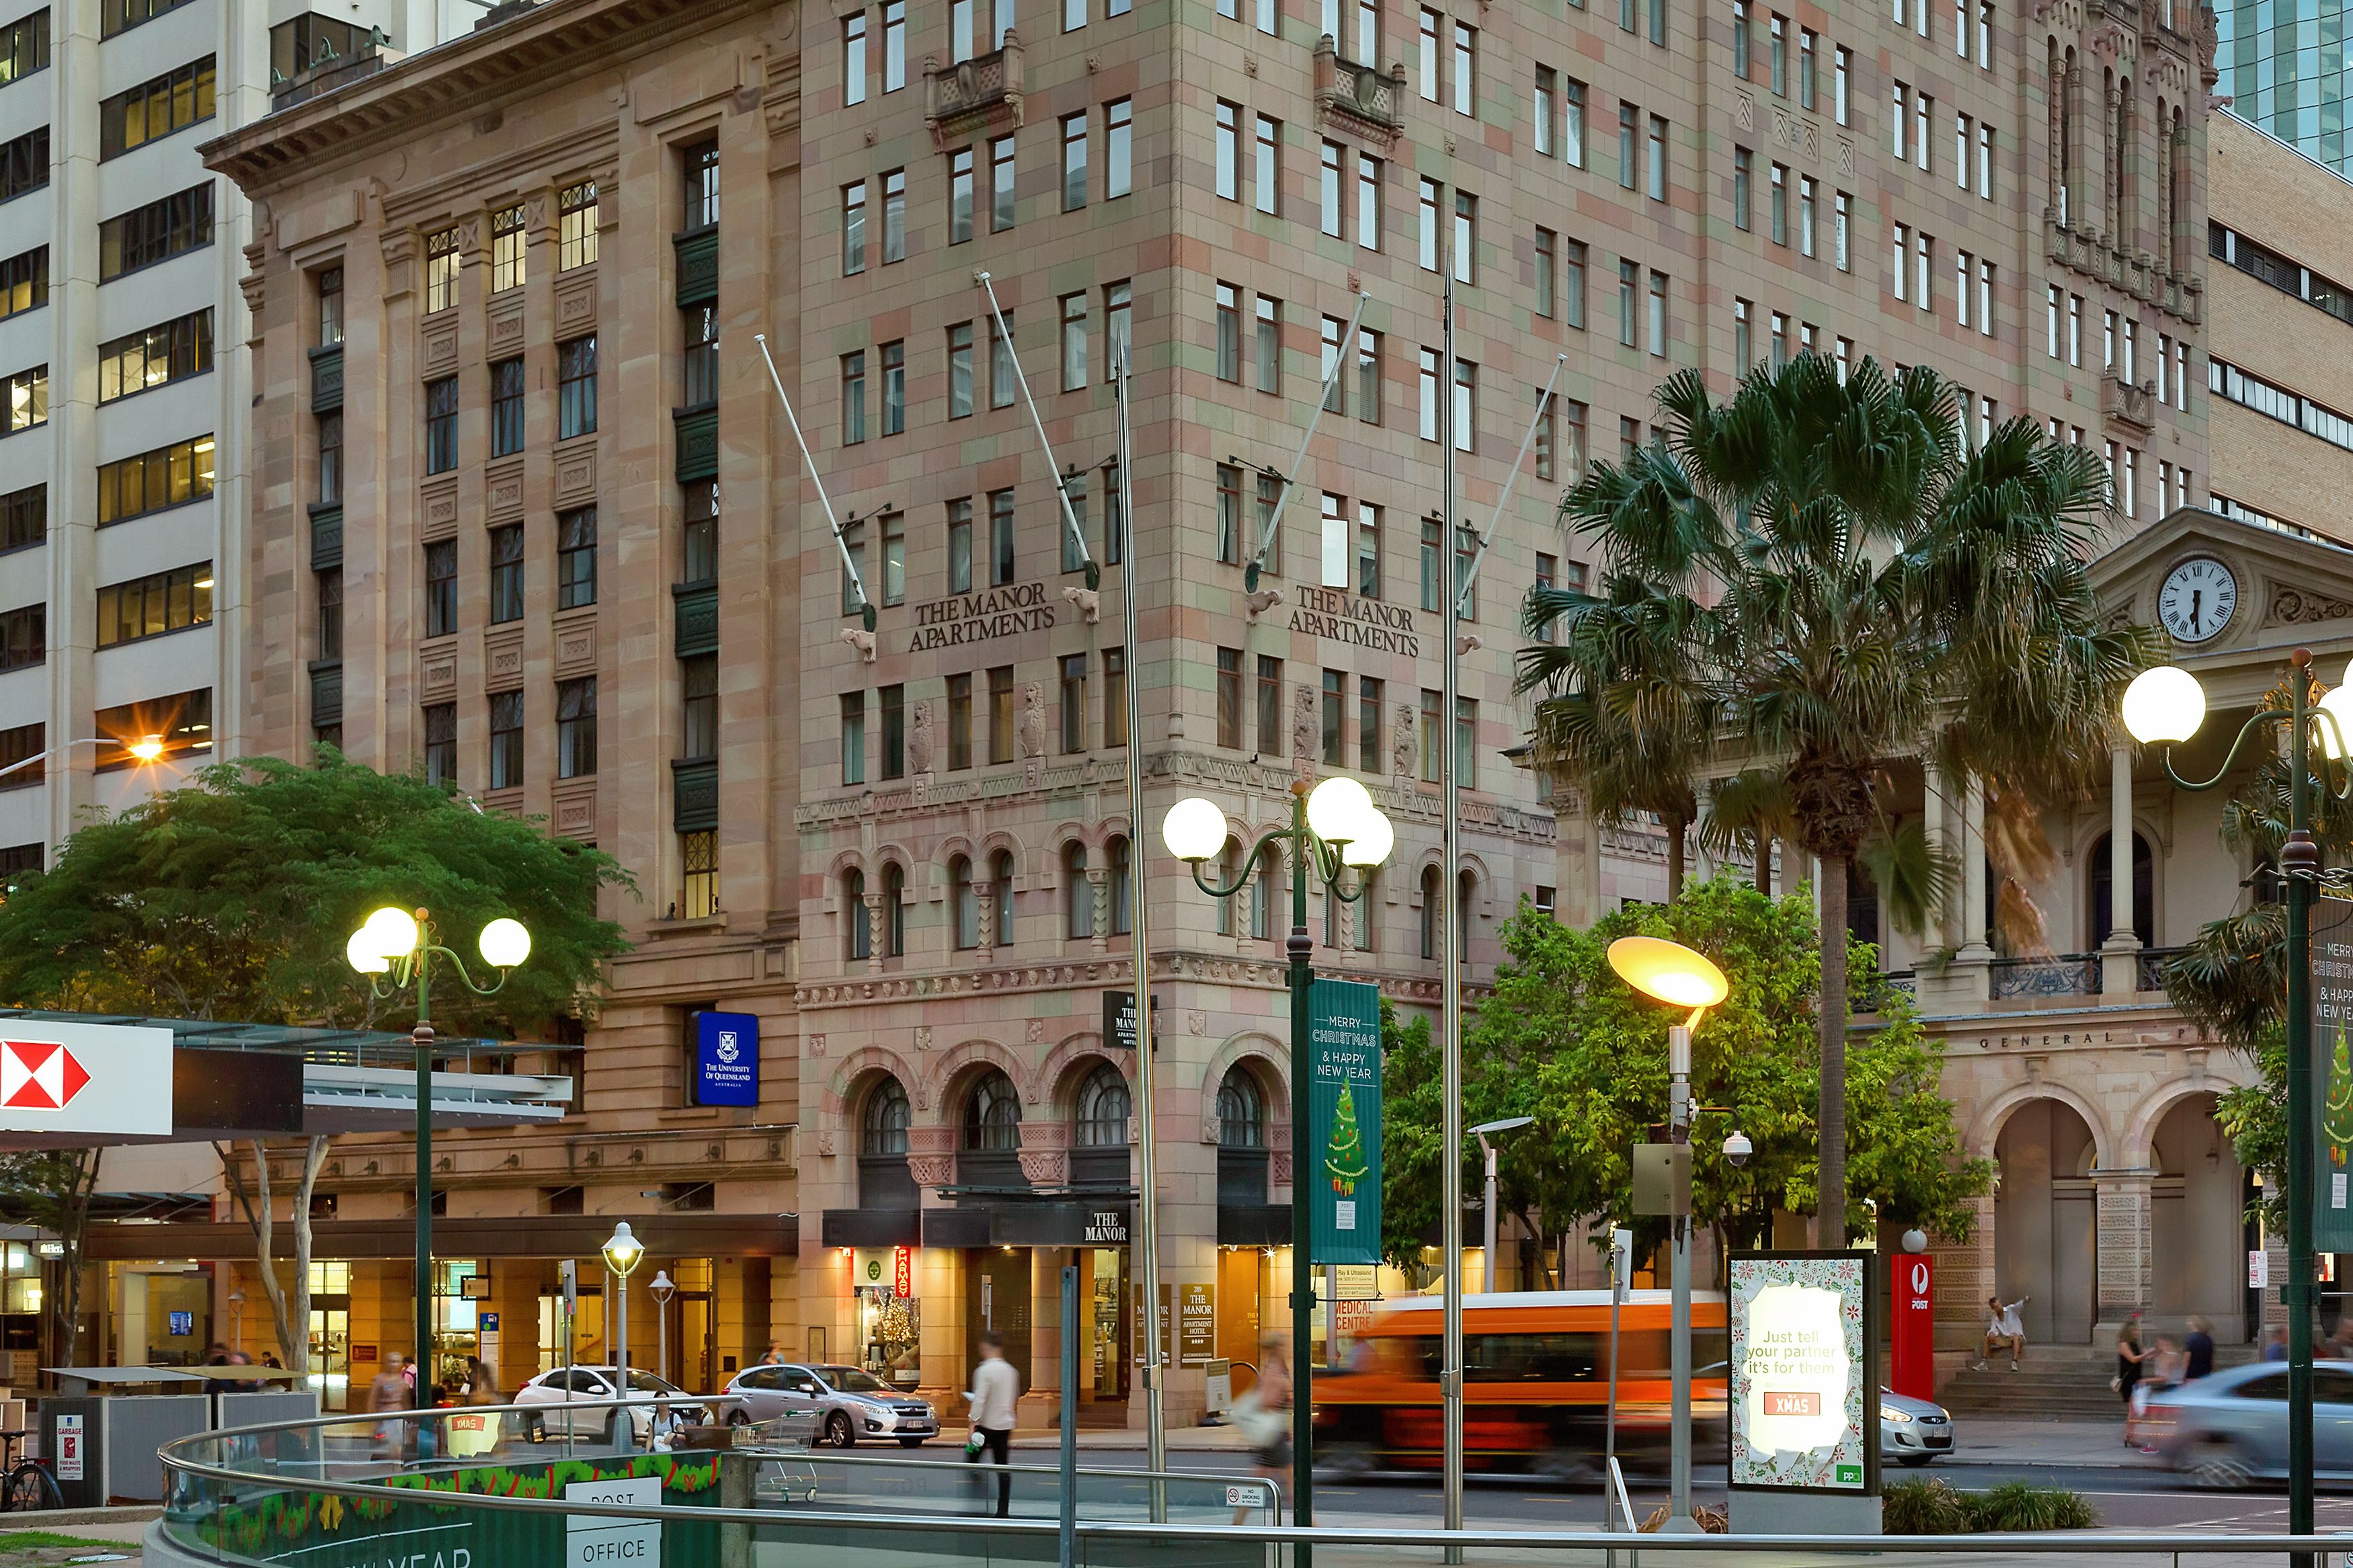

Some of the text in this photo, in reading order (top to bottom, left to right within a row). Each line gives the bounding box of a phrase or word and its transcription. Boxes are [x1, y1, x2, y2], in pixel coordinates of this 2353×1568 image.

[916, 583, 1045, 626] THE MANOR
[1296, 585, 1414, 632] THE MANOR
[909, 606, 1054, 653] APARTMENTS
[1287, 610, 1419, 658] APARTMENTS
[2320, 987, 2328, 1000] &
[2317, 1003, 2353, 1020] NEW YE
[1116, 1018, 1136, 1028] MAN
[1329, 1016, 1361, 1028] MERRY
[1312, 1029, 1376, 1047] CHRISTMAS
[1980, 1032, 2113, 1048] GENERAL
[1322, 1050, 1365, 1065] & HAPPY
[705, 1063, 750, 1073] THE UNIVERSITY
[1318, 1064, 1371, 1079] NEW YEAR
[714, 1072, 750, 1081] QUEENSLAND
[1094, 1212, 1118, 1227] THE
[1085, 1227, 1126, 1241] MANOR
[898, 1249, 908, 1297] PHARMACY
[1189, 1294, 1205, 1304] THE
[1912, 1300, 1929, 1309] POST
[1183, 1305, 1212, 1315] MANOR
[1336, 1301, 1373, 1315] MEDICAL
[1336, 1317, 1371, 1330] CENTRE
[1763, 1331, 1819, 1343] Just tell
[1748, 1346, 1836, 1360] your partner
[1749, 1361, 1835, 1374] it's for them
[1776, 1398, 1808, 1413] XMAS
[1843, 1472, 1861, 1482] PPQ
[583, 1540, 645, 1563] OFFICE
